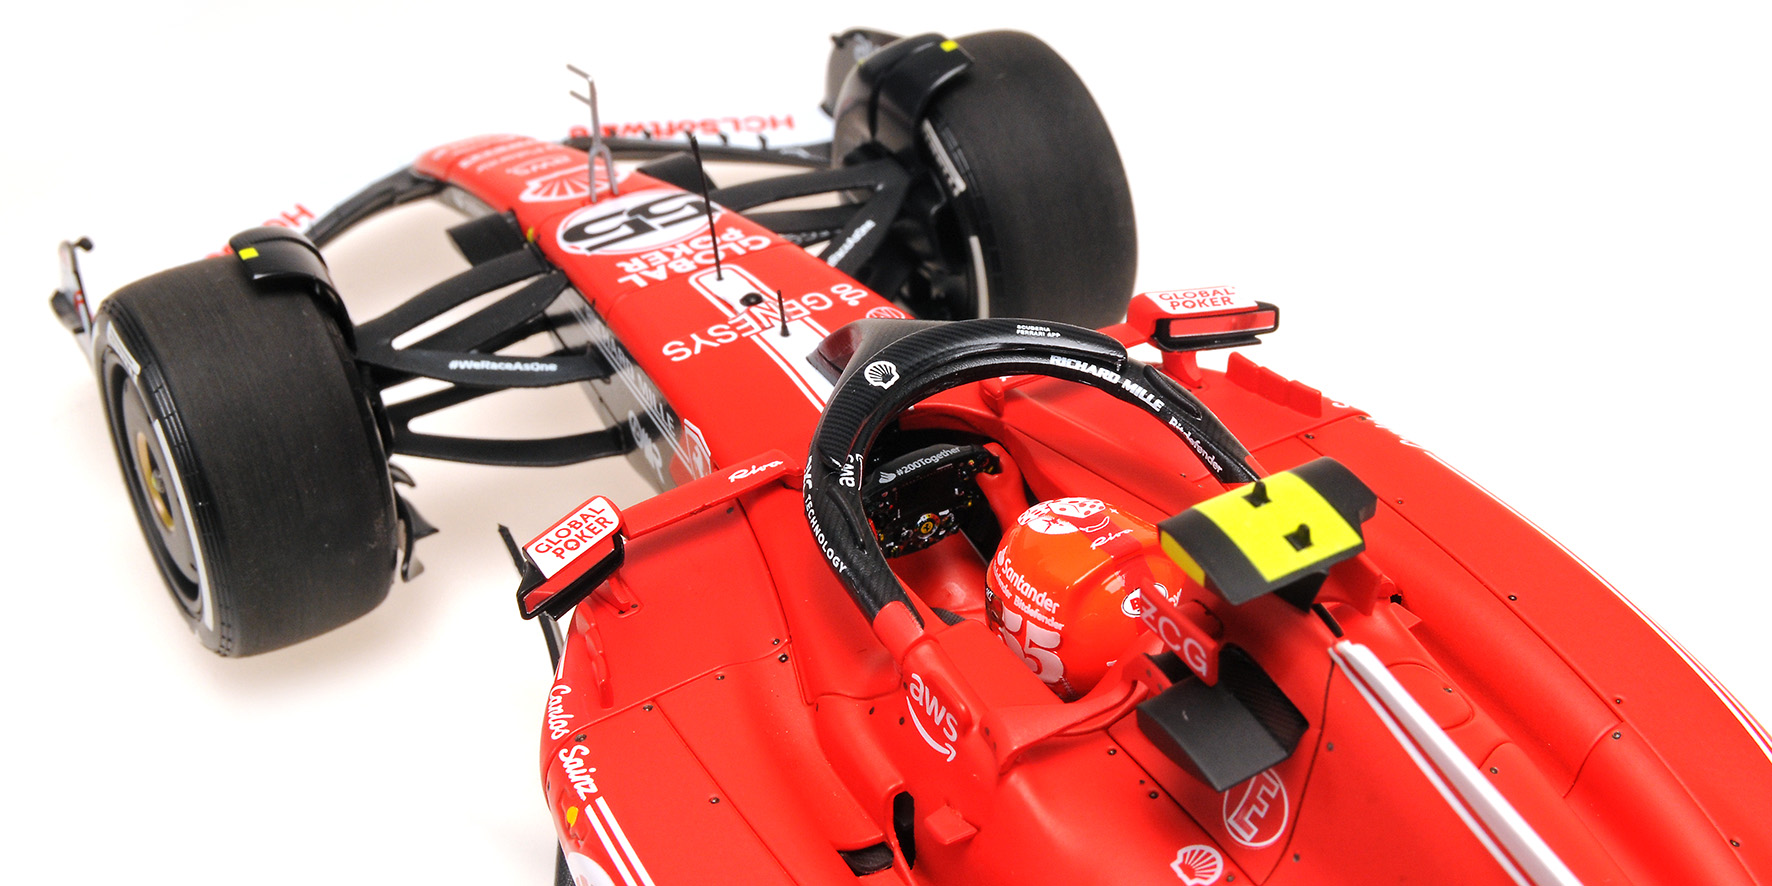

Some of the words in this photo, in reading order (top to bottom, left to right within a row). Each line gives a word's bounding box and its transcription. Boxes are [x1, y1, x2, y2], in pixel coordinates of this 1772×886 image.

[569, 114, 795, 139] HCLSoftwae
[562, 193, 721, 253] 55
[615, 227, 745, 273] POKER
[617, 235, 771, 288] GLOBAL
[1159, 287, 1235, 301] GLOBAL
[1169, 296, 1234, 310] POKER
[662, 292, 833, 362] GENESYS
[1016, 329, 1046, 337] FERRARI
[448, 359, 558, 373] #WeRaceAsOne
[1050, 355, 1121, 384] RICHARD
[1121, 379, 1165, 413] MILLE
[727, 460, 784, 483] Riva
[896, 445, 962, 477] #200Together
[534, 507, 605, 553] GLOBAL
[551, 516, 614, 559] POKER
[804, 493, 847, 574] TECHNOLOGY
[1089, 529, 1134, 550] Riva
[1002, 558, 1060, 614] Santander
[1013, 594, 1065, 630] Bitdefender
[548, 684, 574, 741] Carlos
[910, 672, 959, 743] aws
[558, 744, 599, 801] Sainz
